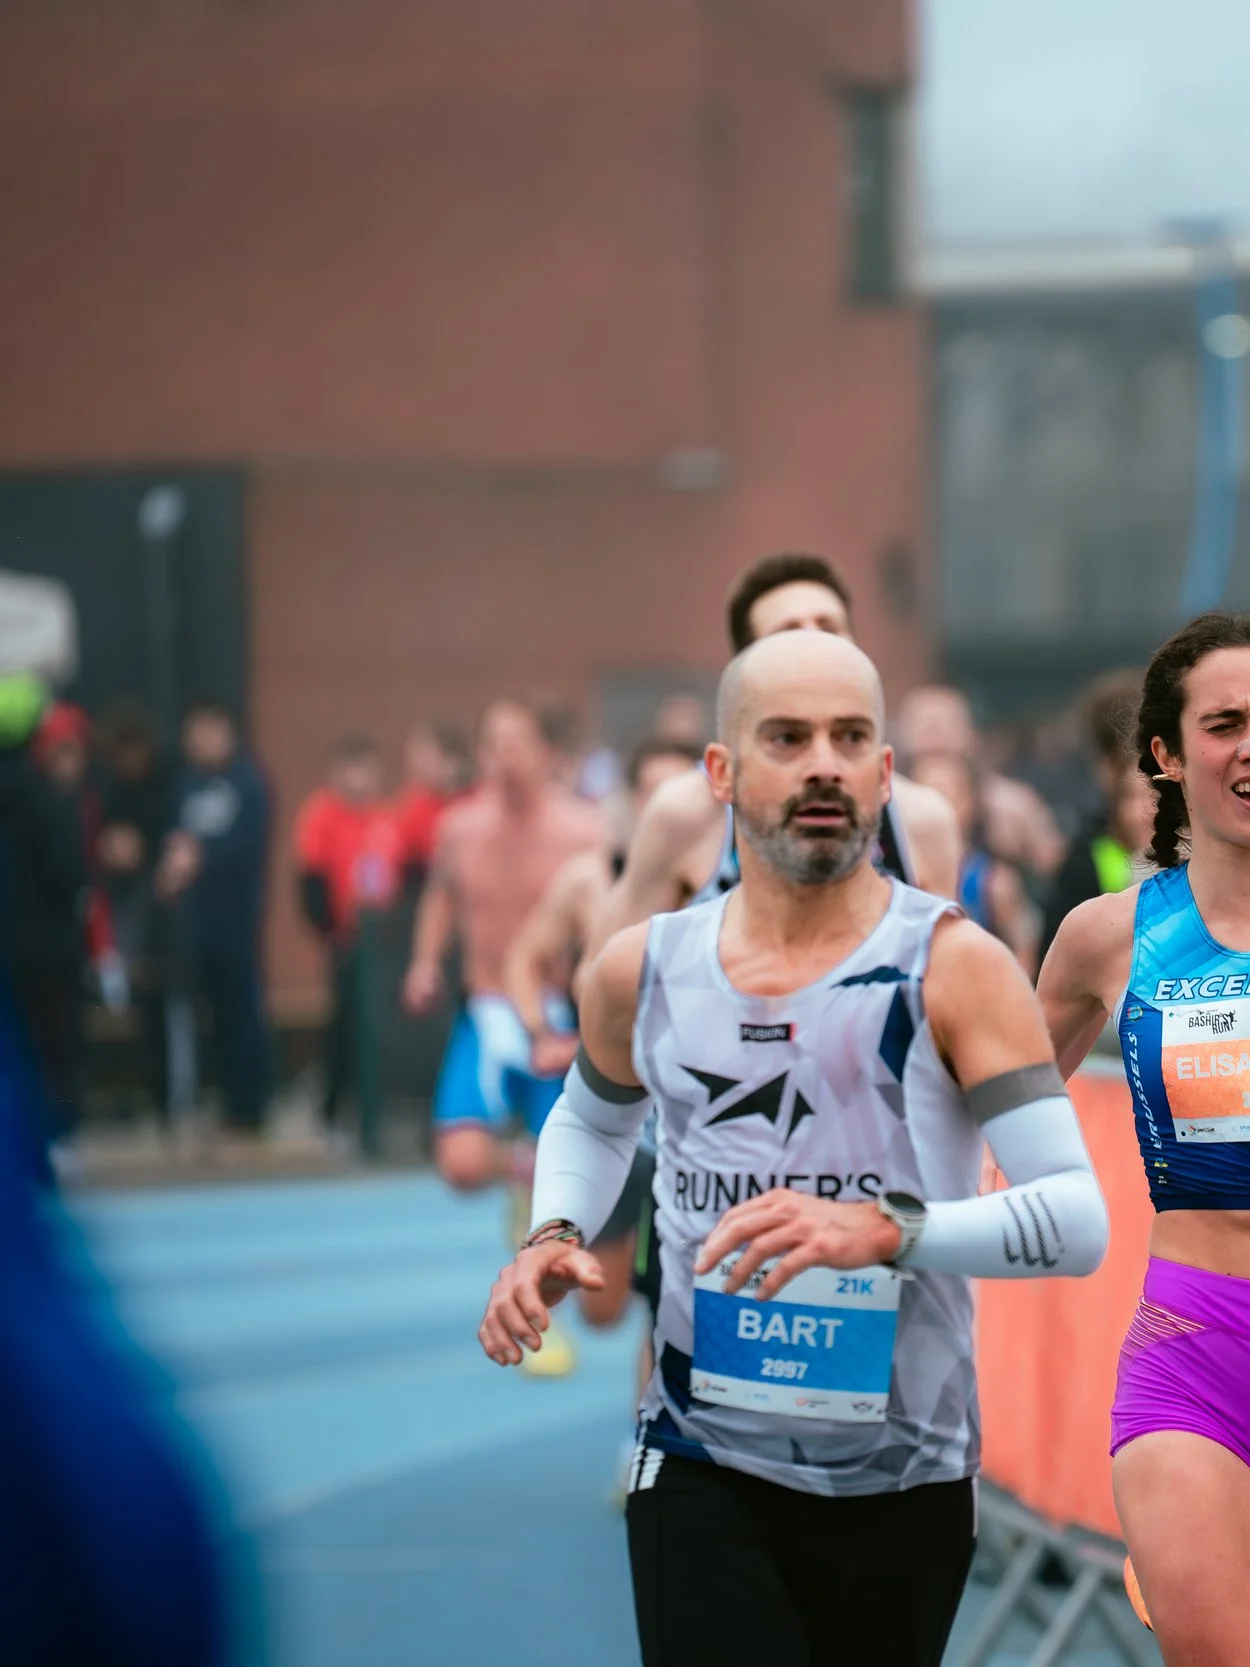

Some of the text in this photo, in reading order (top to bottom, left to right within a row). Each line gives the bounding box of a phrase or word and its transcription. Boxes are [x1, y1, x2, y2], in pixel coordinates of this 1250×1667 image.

[836, 1277, 875, 1295] 21K
[737, 1307, 844, 1349] BART
[760, 1357, 809, 1380] 2997
